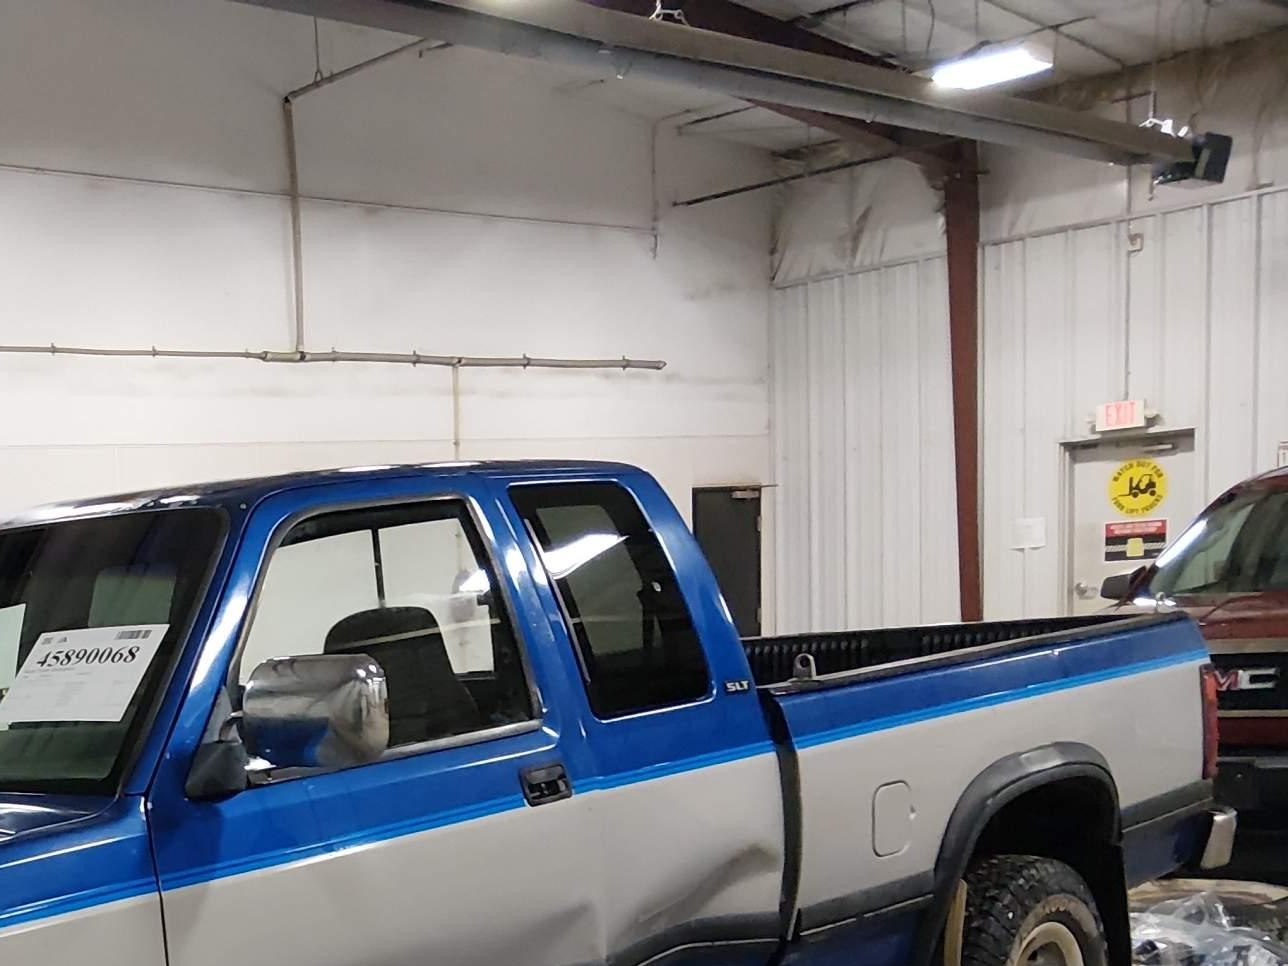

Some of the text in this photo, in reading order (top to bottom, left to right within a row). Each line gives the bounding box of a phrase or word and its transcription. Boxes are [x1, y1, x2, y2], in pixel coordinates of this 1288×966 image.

[1105, 401, 1136, 427] EXIT
[36, 646, 140, 668] 45890068
[725, 680, 750, 692] SLT
[1214, 667, 1278, 691] MC
